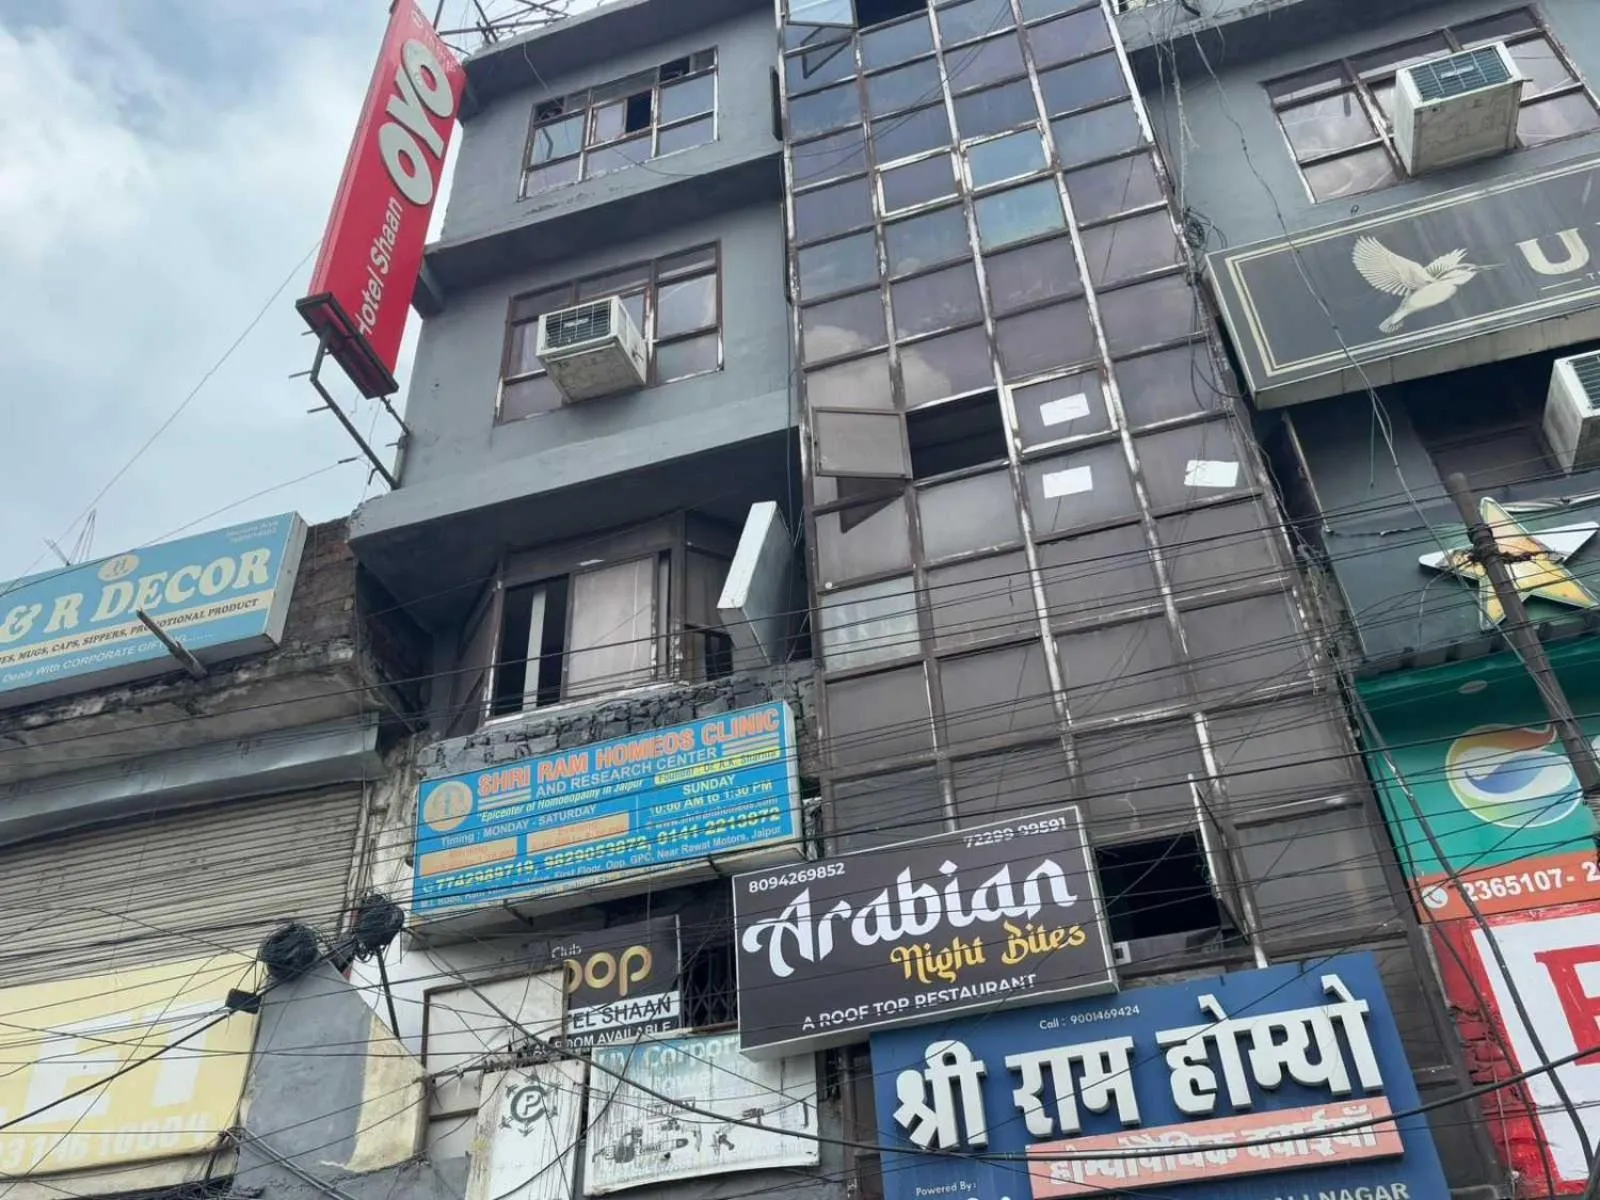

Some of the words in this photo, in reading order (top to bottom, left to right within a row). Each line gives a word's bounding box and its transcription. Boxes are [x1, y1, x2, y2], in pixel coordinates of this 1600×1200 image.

[378, 37, 454, 206] OYO
[355, 264, 384, 335] Hotel
[370, 196, 403, 274] Shaan
[44, 593, 83, 633] R
[90, 547, 271, 622] DECOR
[207, 597, 260, 617] PRODUCT
[478, 764, 532, 797] SHRI
[537, 751, 589, 784] RAM
[595, 728, 695, 771] HOMEOS
[701, 708, 780, 746] CLINIC
[536, 781, 567, 798] AND
[571, 761, 652, 791] RESEARCH
[656, 746, 718, 771] CENTER
[683, 774, 736, 795] SUNDAY
[684, 795, 704, 809] AM
[706, 792, 720, 805] to
[752, 779, 773, 793] PM
[441, 832, 475, 849] Timing
[483, 820, 529, 837] MONDAY
[539, 804, 598, 826] SATURDAY
[751, 825, 781, 840] Jaipur
[749, 862, 846, 894] 8094269852
[741, 859, 1078, 978] Arabian
[551, 943, 583, 959] Club
[890, 936, 986, 984] Night
[1001, 921, 1087, 966] Bites
[602, 996, 672, 1025] SHAAN
[802, 1016, 816, 1032] A
[819, 1005, 869, 1028] ROOF
[873, 998, 910, 1017] TOP
[915, 973, 1038, 1009] RESTAURANT
[1039, 1018, 1059, 1030] Call
[1070, 1004, 1140, 1025] 9001469424
[892, 1040, 989, 1151] श्री
[1005, 1036, 1141, 1138] राम
[1155, 973, 1384, 1116] होम्यो
[915, 1183, 957, 1197] Powered
